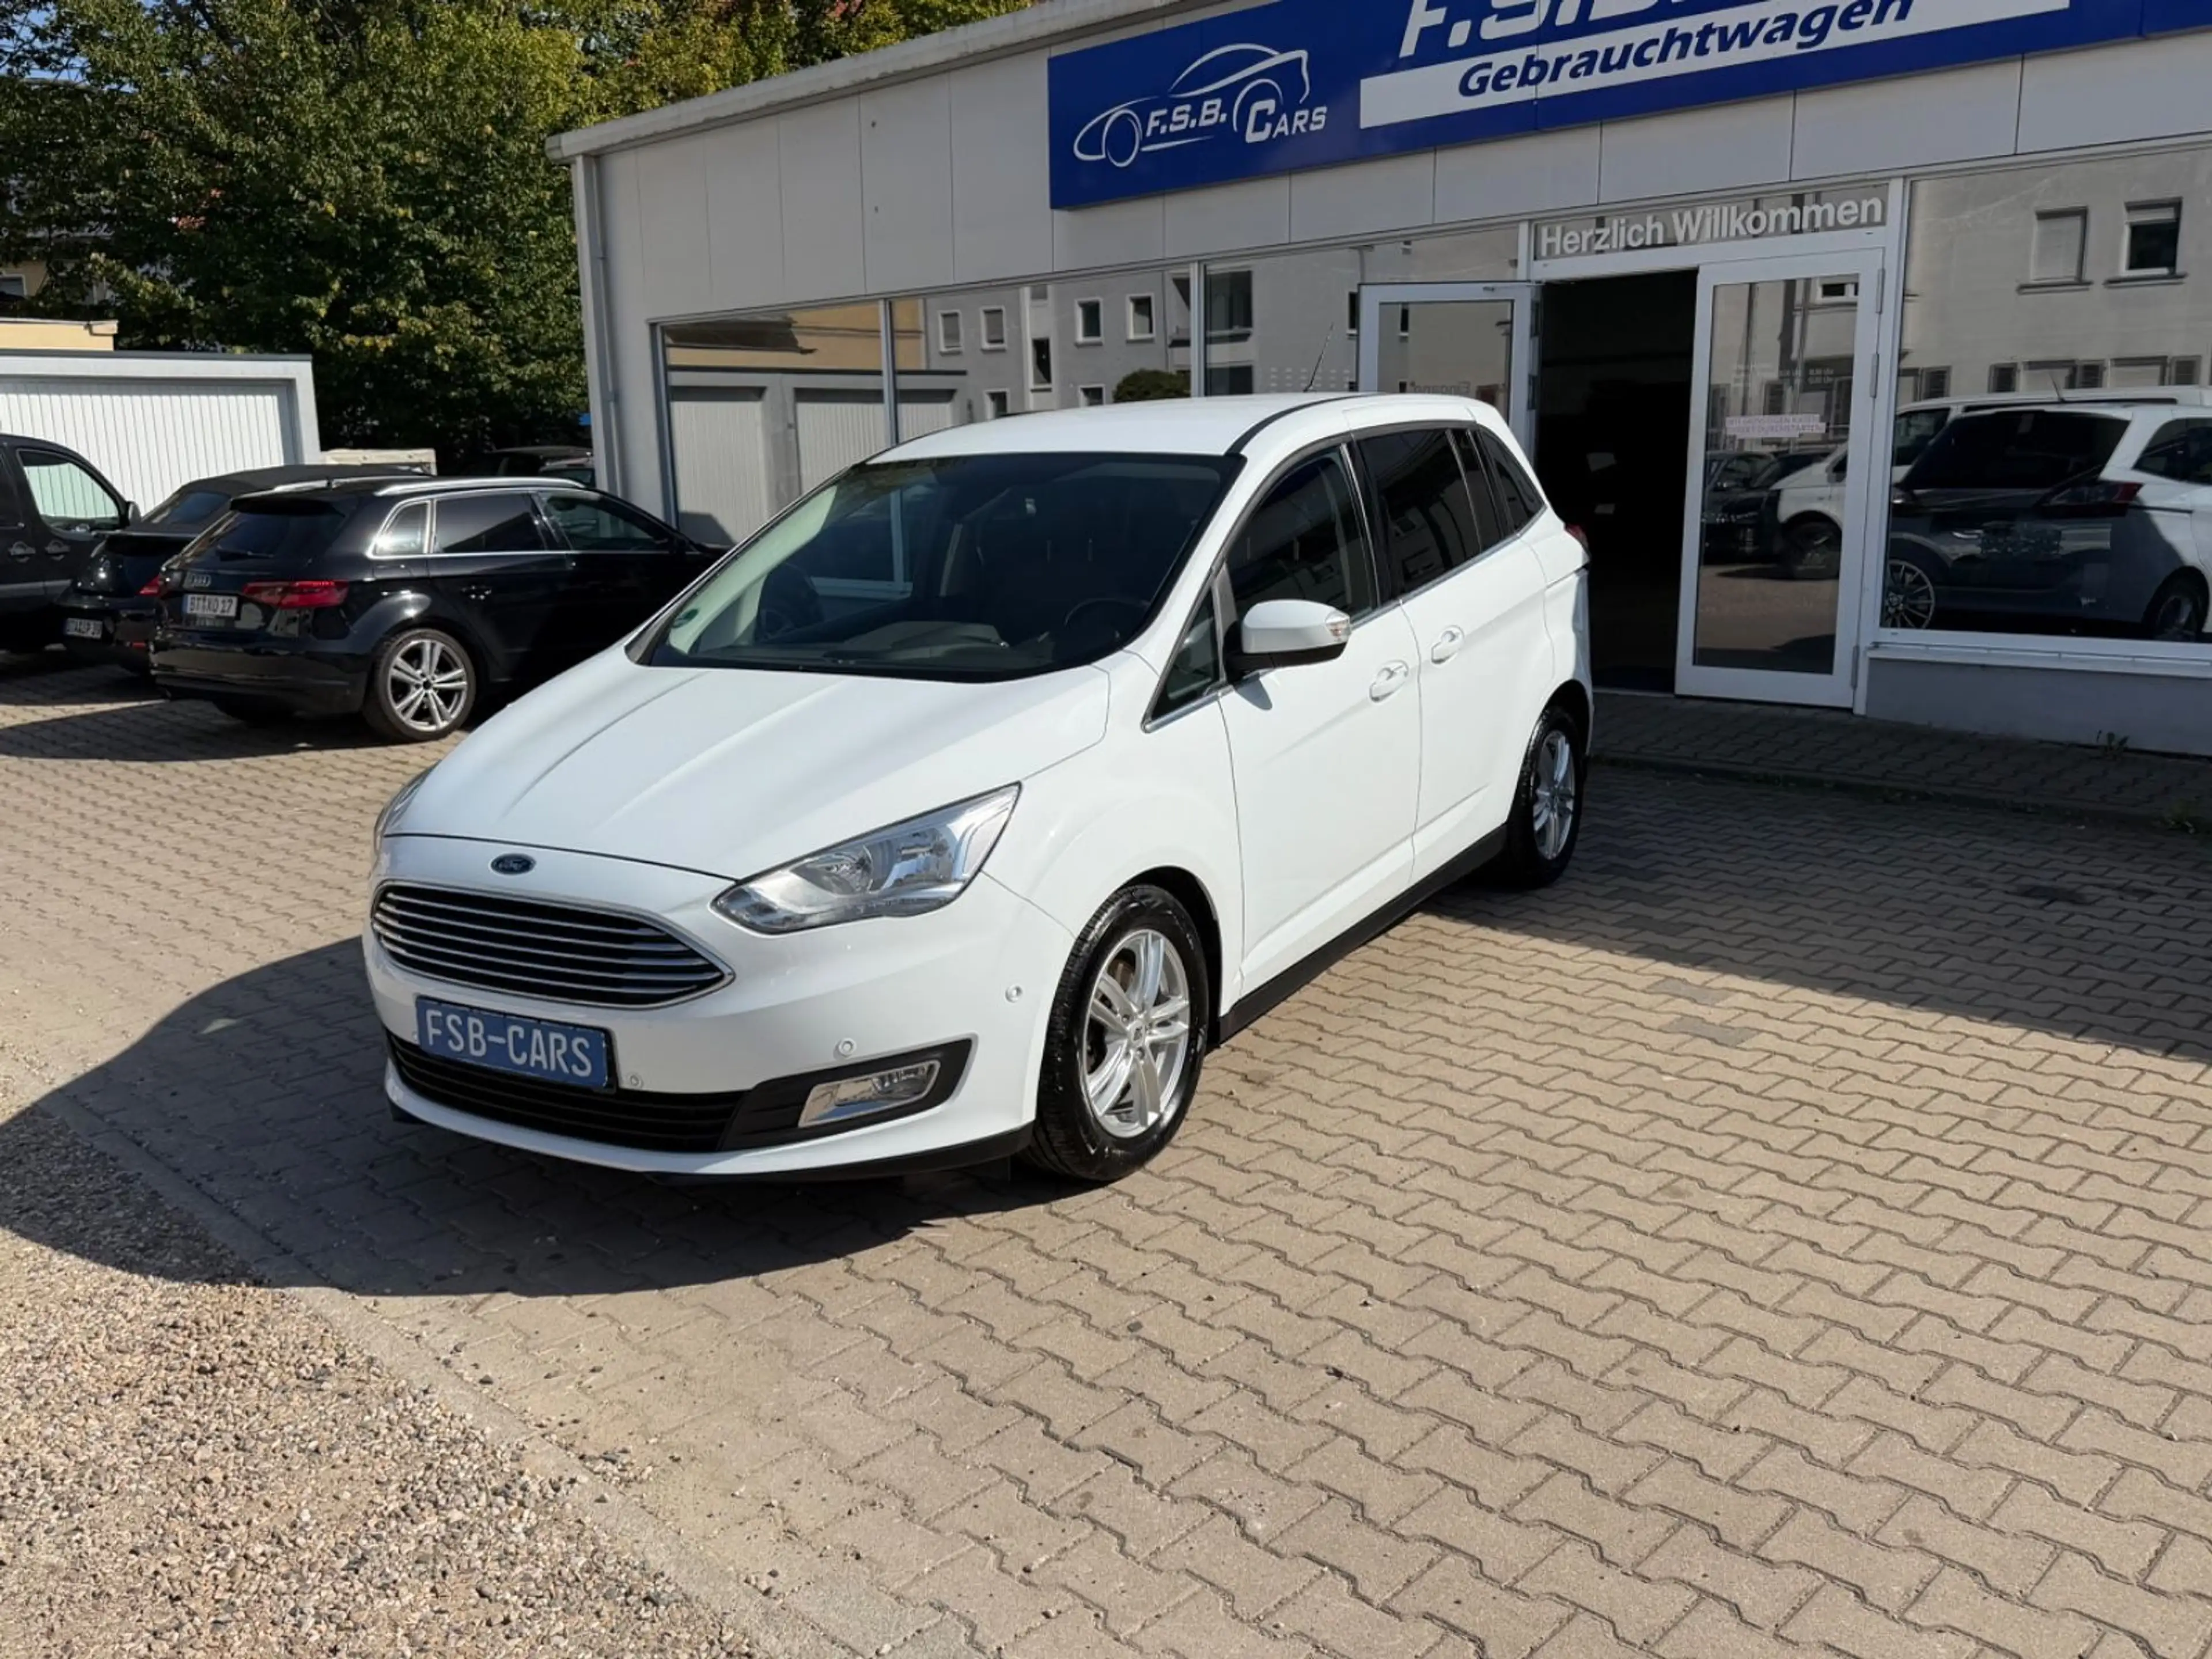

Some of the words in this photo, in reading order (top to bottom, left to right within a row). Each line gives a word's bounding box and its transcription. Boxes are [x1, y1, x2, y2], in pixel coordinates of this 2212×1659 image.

[1459, 0, 1915, 97] Gebrauchtwagen
[1146, 98, 1228, 137] F.S.B.
[1540, 214, 1664, 257] Herzlich
[1672, 196, 1883, 243] Willkommen
[425, 1010, 592, 1077] FSB-CARS
